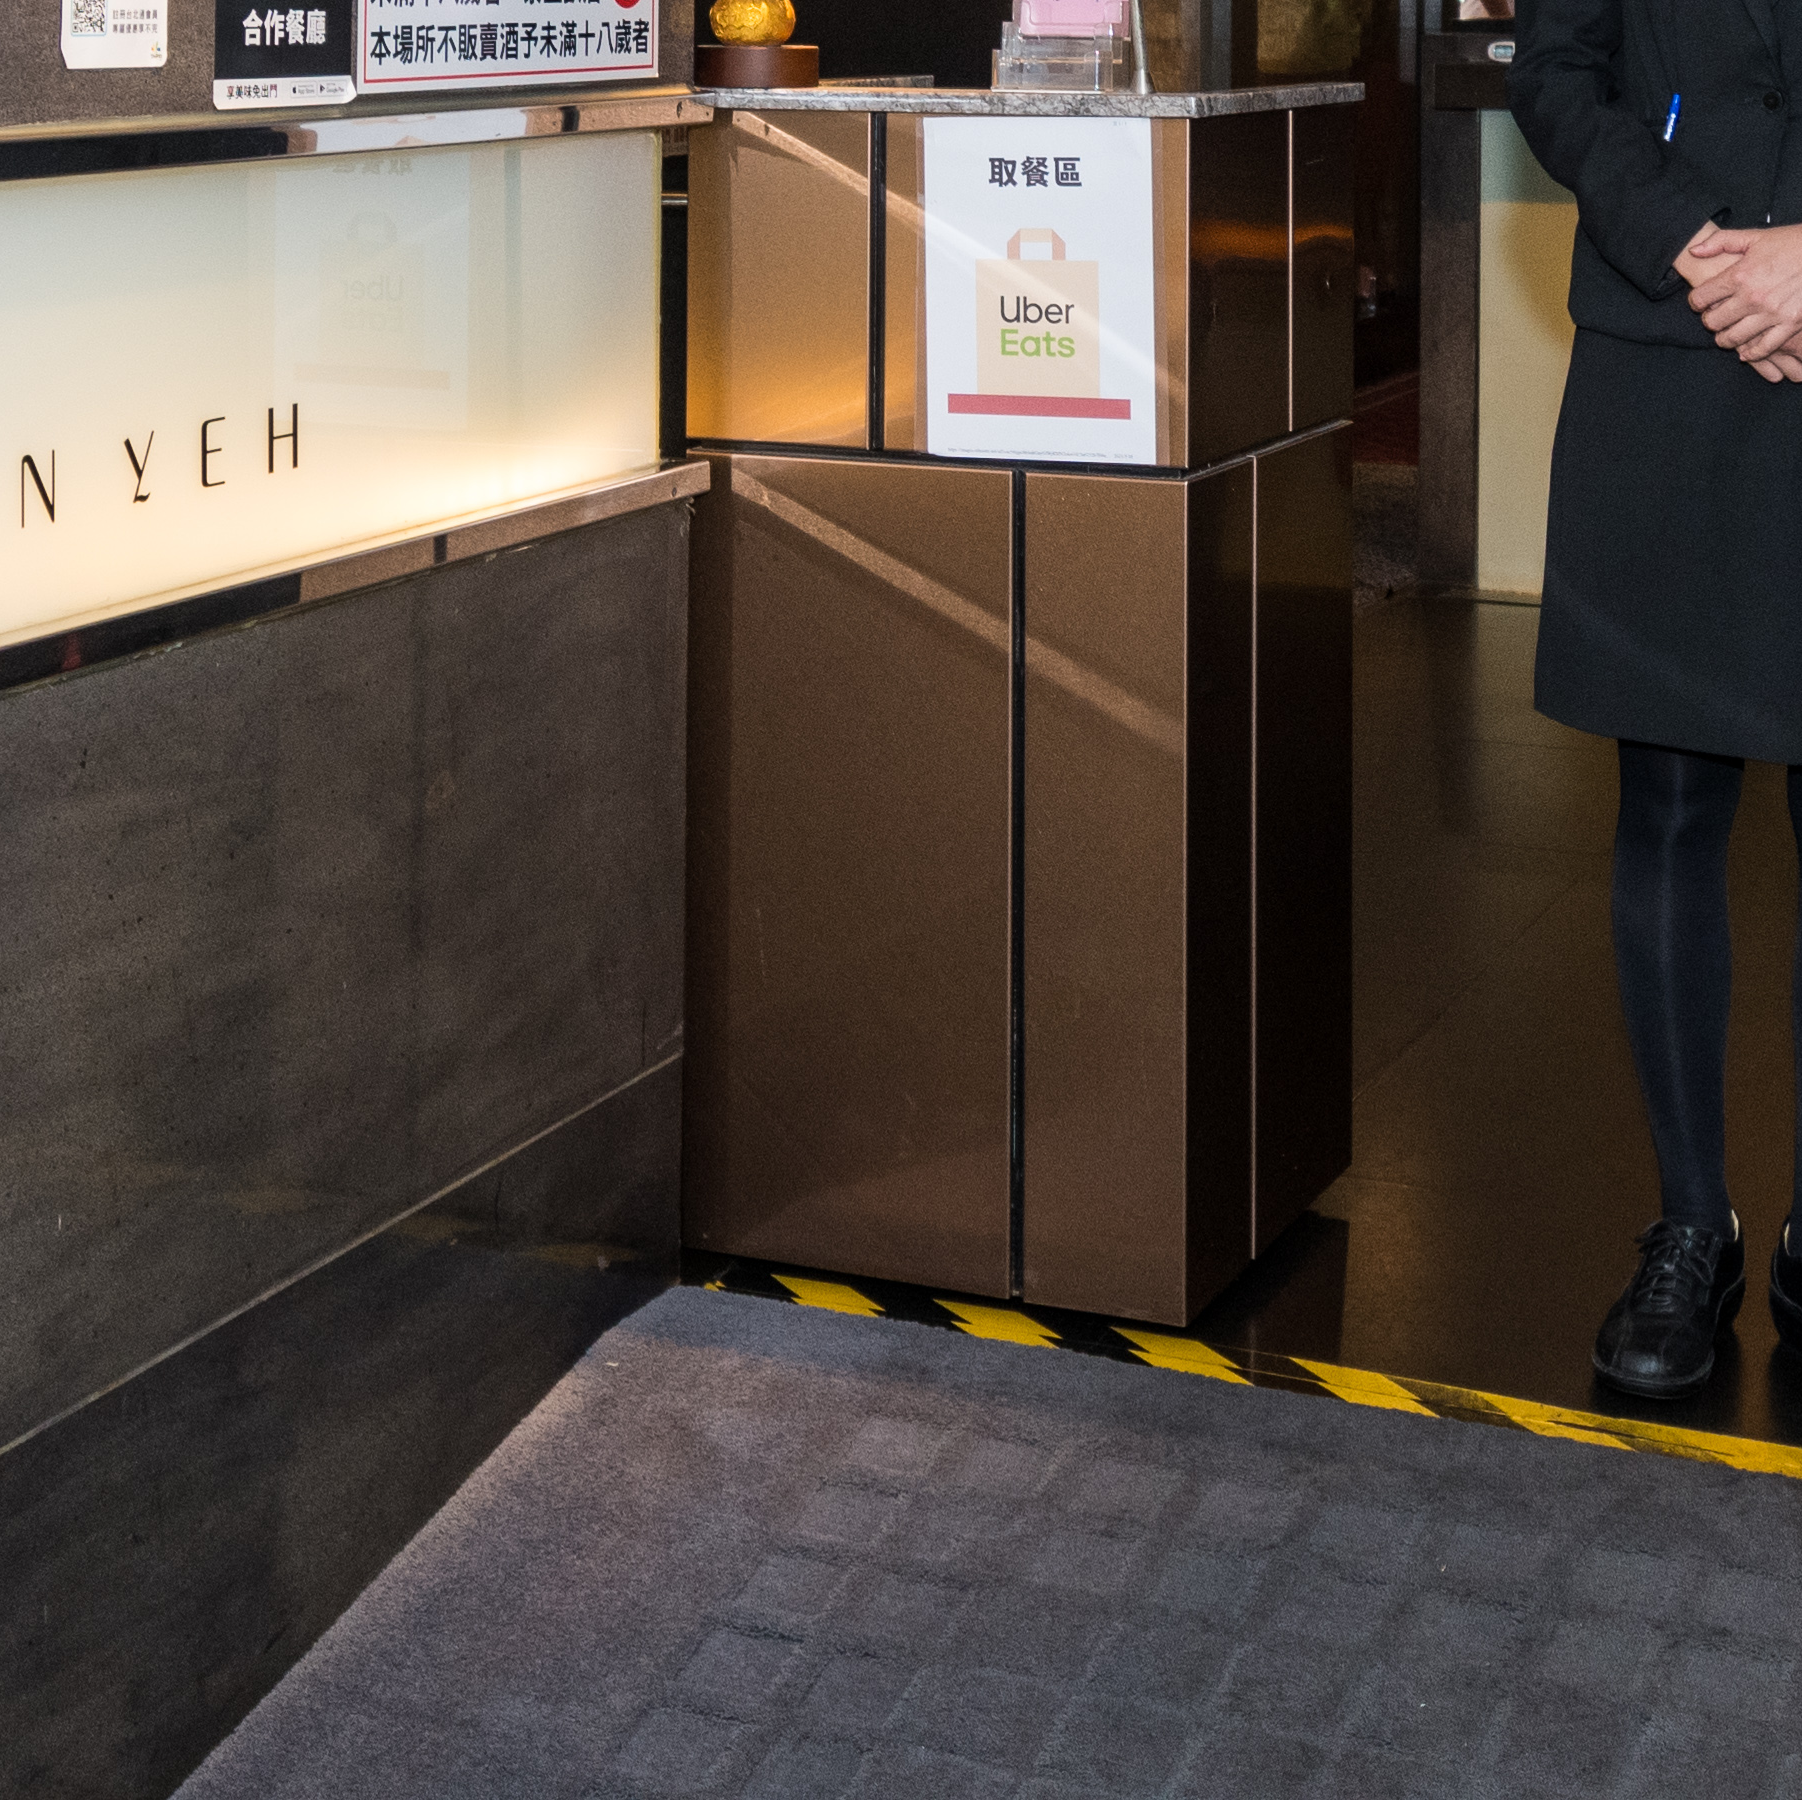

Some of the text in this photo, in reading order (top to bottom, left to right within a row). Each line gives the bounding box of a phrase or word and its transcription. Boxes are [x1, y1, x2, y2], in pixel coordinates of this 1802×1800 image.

[243, 9, 327, 46] 合作餐廳
[370, 19, 650, 65] 本場所不販賣酒予未滿十八歲者
[988, 156, 1083, 188] 取餐區
[999, 295, 1075, 324] Uber
[1000, 329, 1075, 358] Eats
[123, 403, 298, 504] YEH
